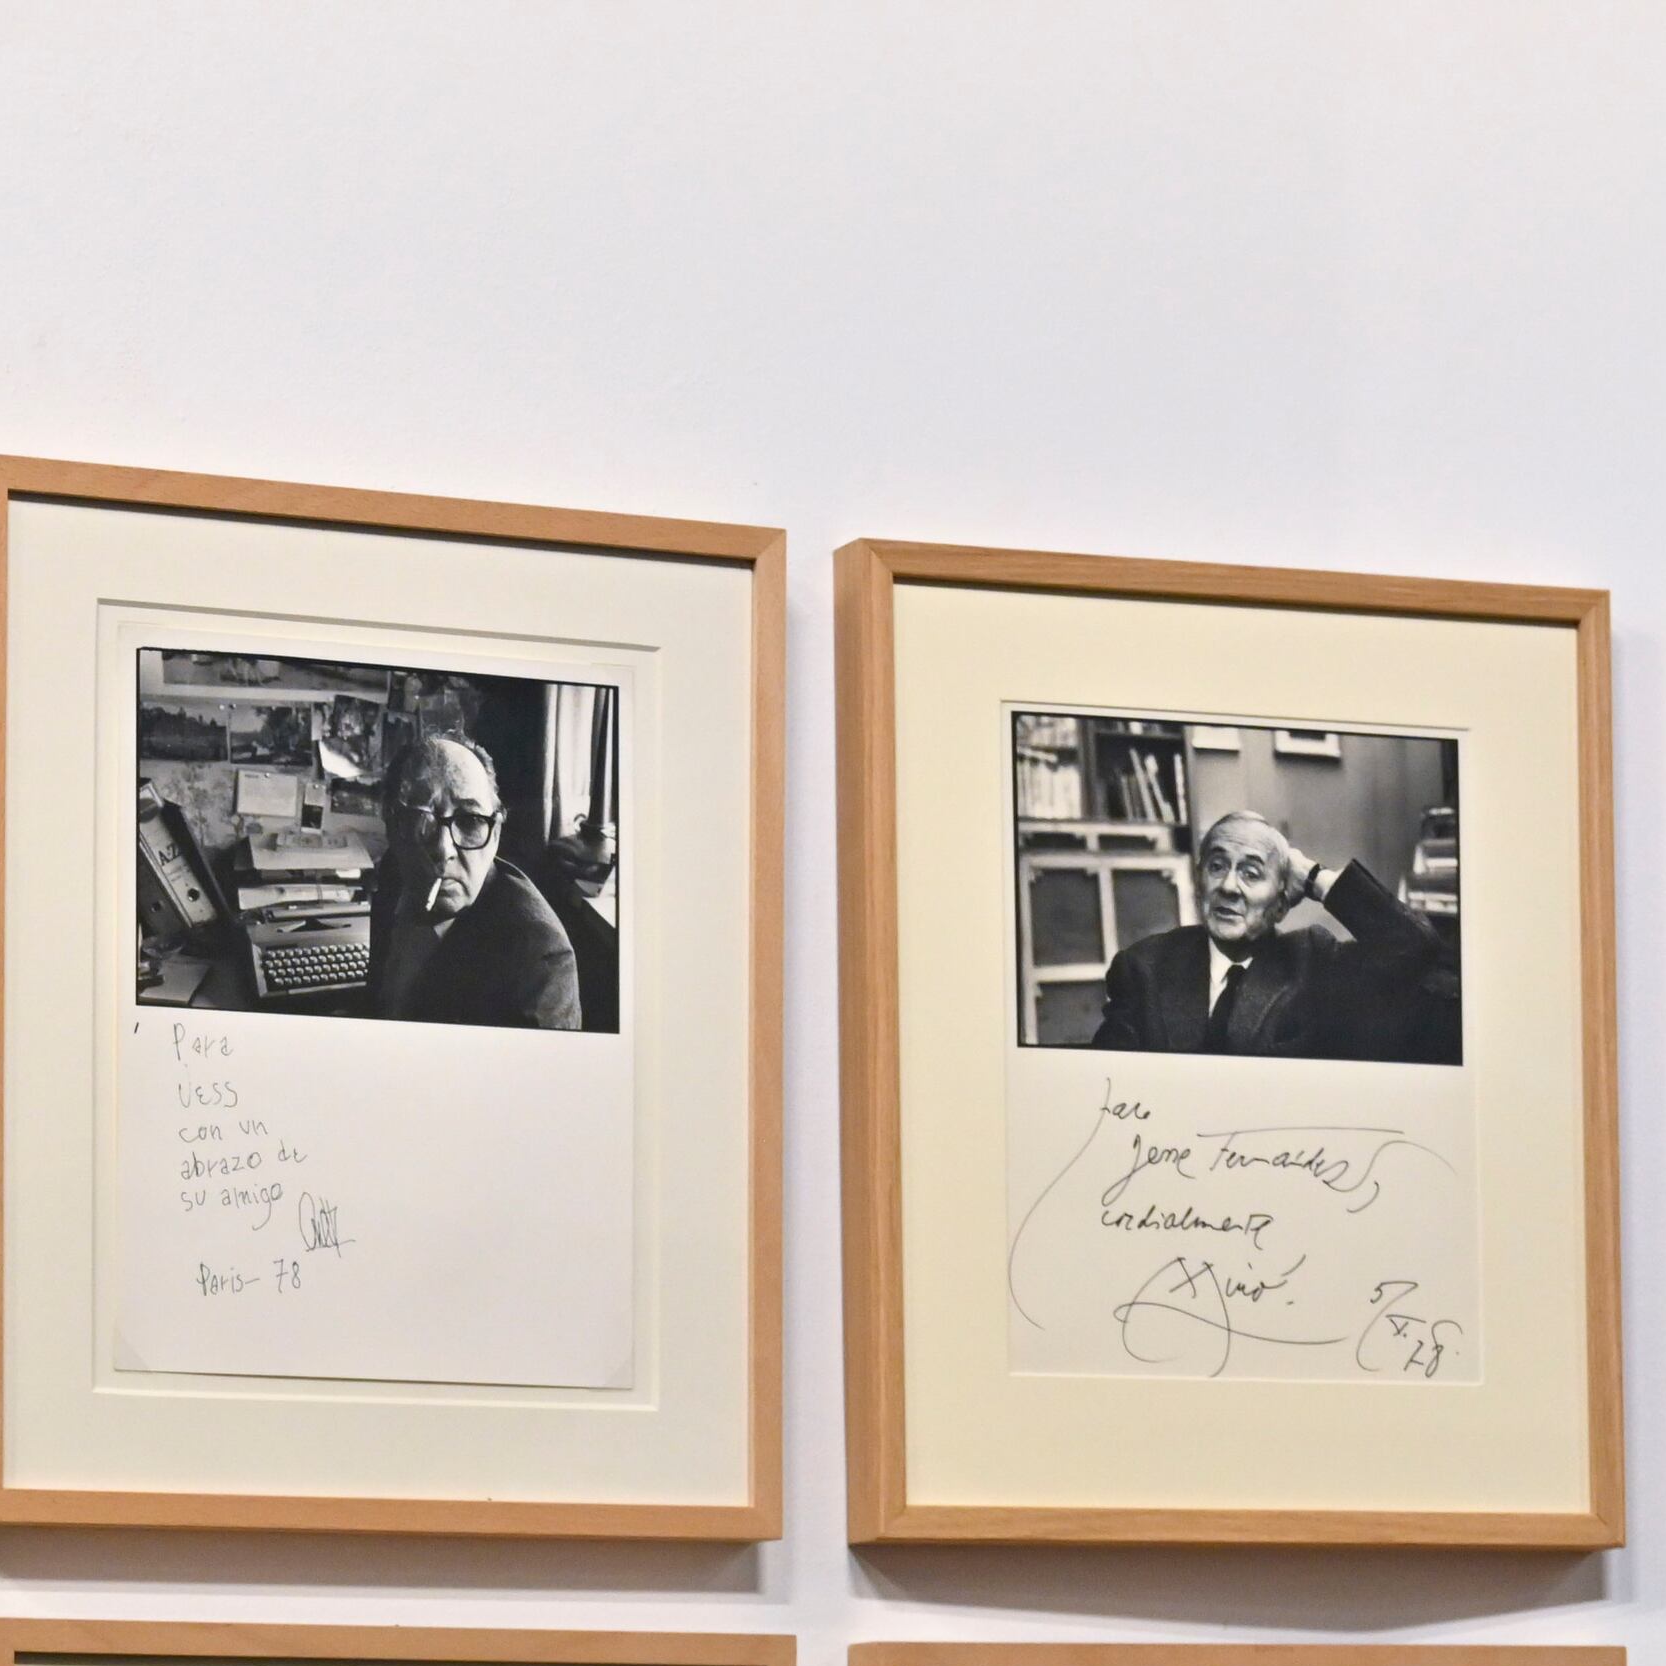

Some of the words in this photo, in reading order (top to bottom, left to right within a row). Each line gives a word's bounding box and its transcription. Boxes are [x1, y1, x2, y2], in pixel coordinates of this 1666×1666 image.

[180, 1150, 263, 1181] abrazo
[221, 1182, 284, 1232] amigo
[272, 1257, 302, 1294] 78
